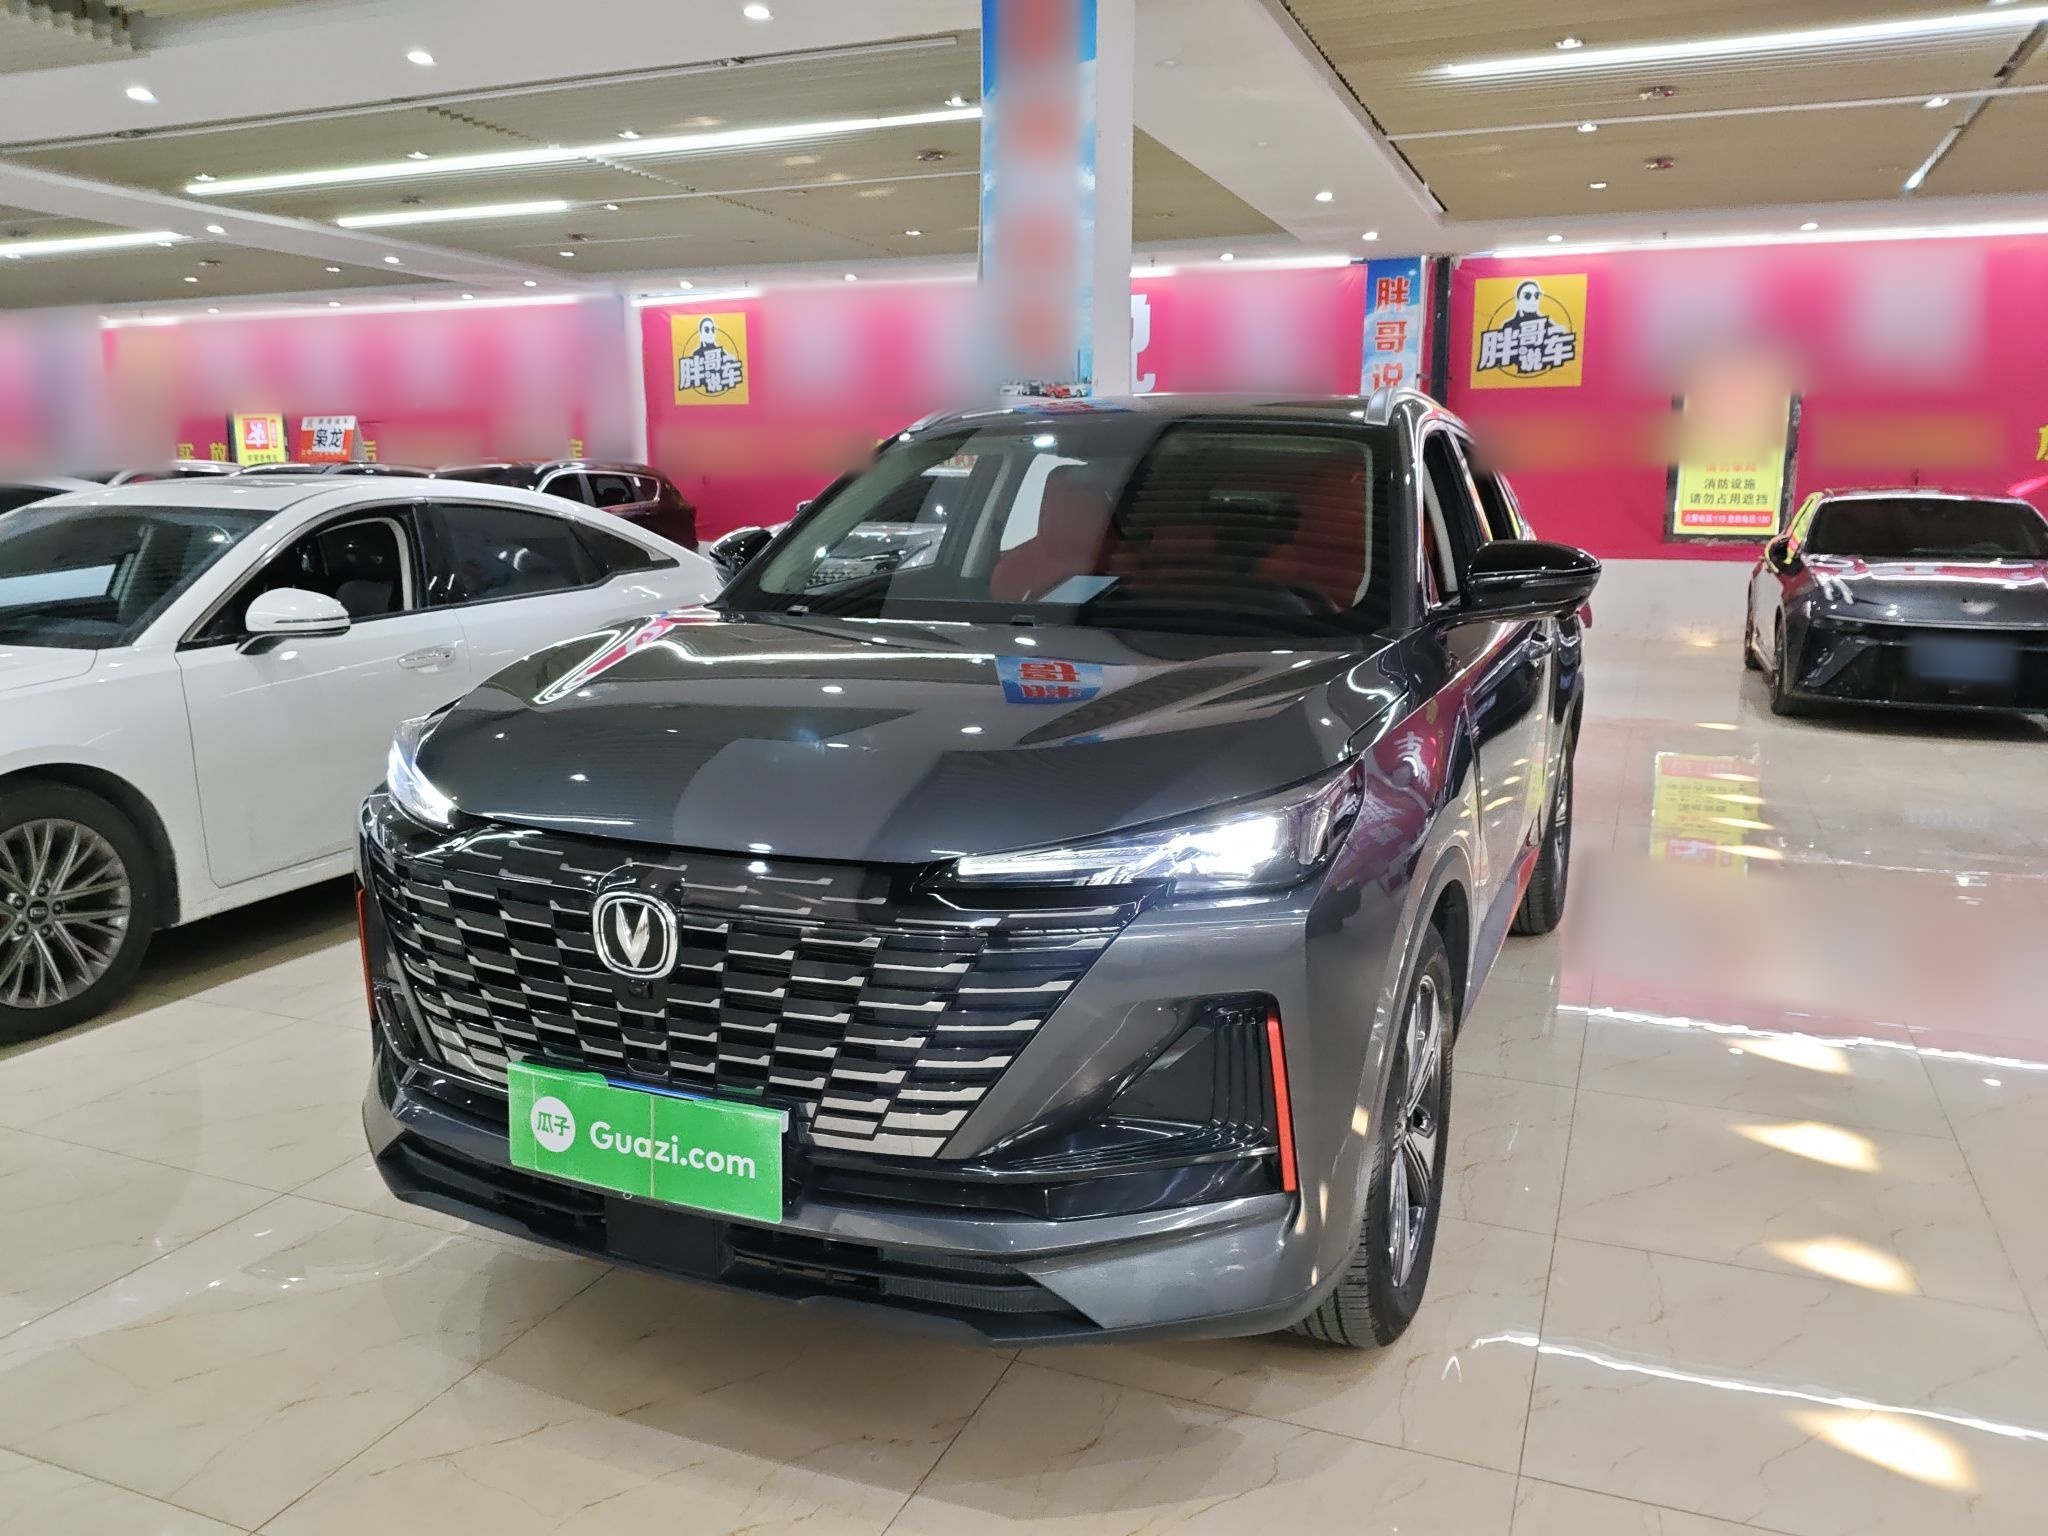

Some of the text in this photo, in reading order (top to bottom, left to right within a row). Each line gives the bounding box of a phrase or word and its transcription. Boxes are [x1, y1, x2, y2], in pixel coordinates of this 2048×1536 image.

[1477, 316, 1576, 373] 胖哥说车
[679, 347, 743, 393] 胖哥说车
[1690, 493, 1769, 505] 请勿占用遮挡
[1704, 478, 1756, 490] 消防设施
[537, 1111, 570, 1136] 瓜子
[590, 1121, 756, 1179] Guazi.com
